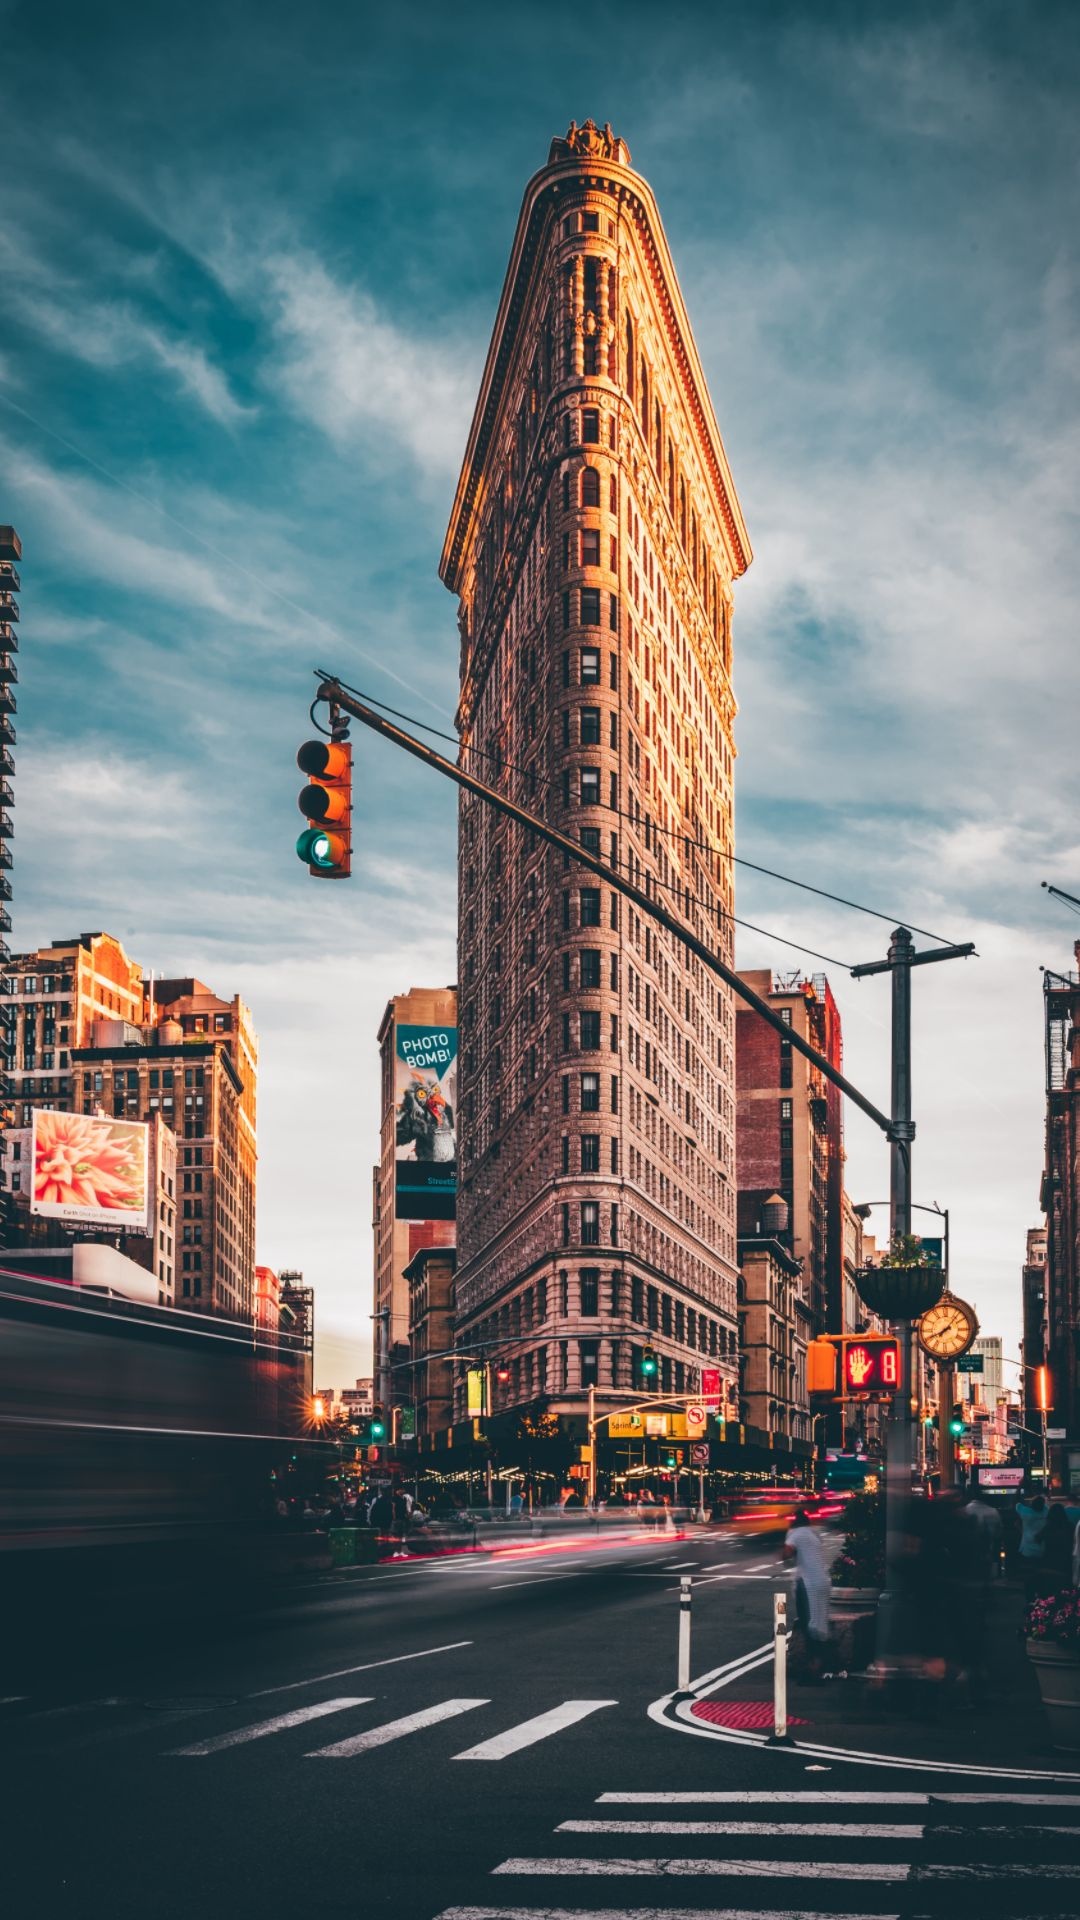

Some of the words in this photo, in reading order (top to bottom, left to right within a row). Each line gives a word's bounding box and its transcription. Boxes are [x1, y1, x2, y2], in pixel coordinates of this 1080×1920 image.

[402, 1034, 449, 1053] PHOTO
[406, 1048, 452, 1069] BOMB!
[612, 1422, 632, 1430] Sprint
